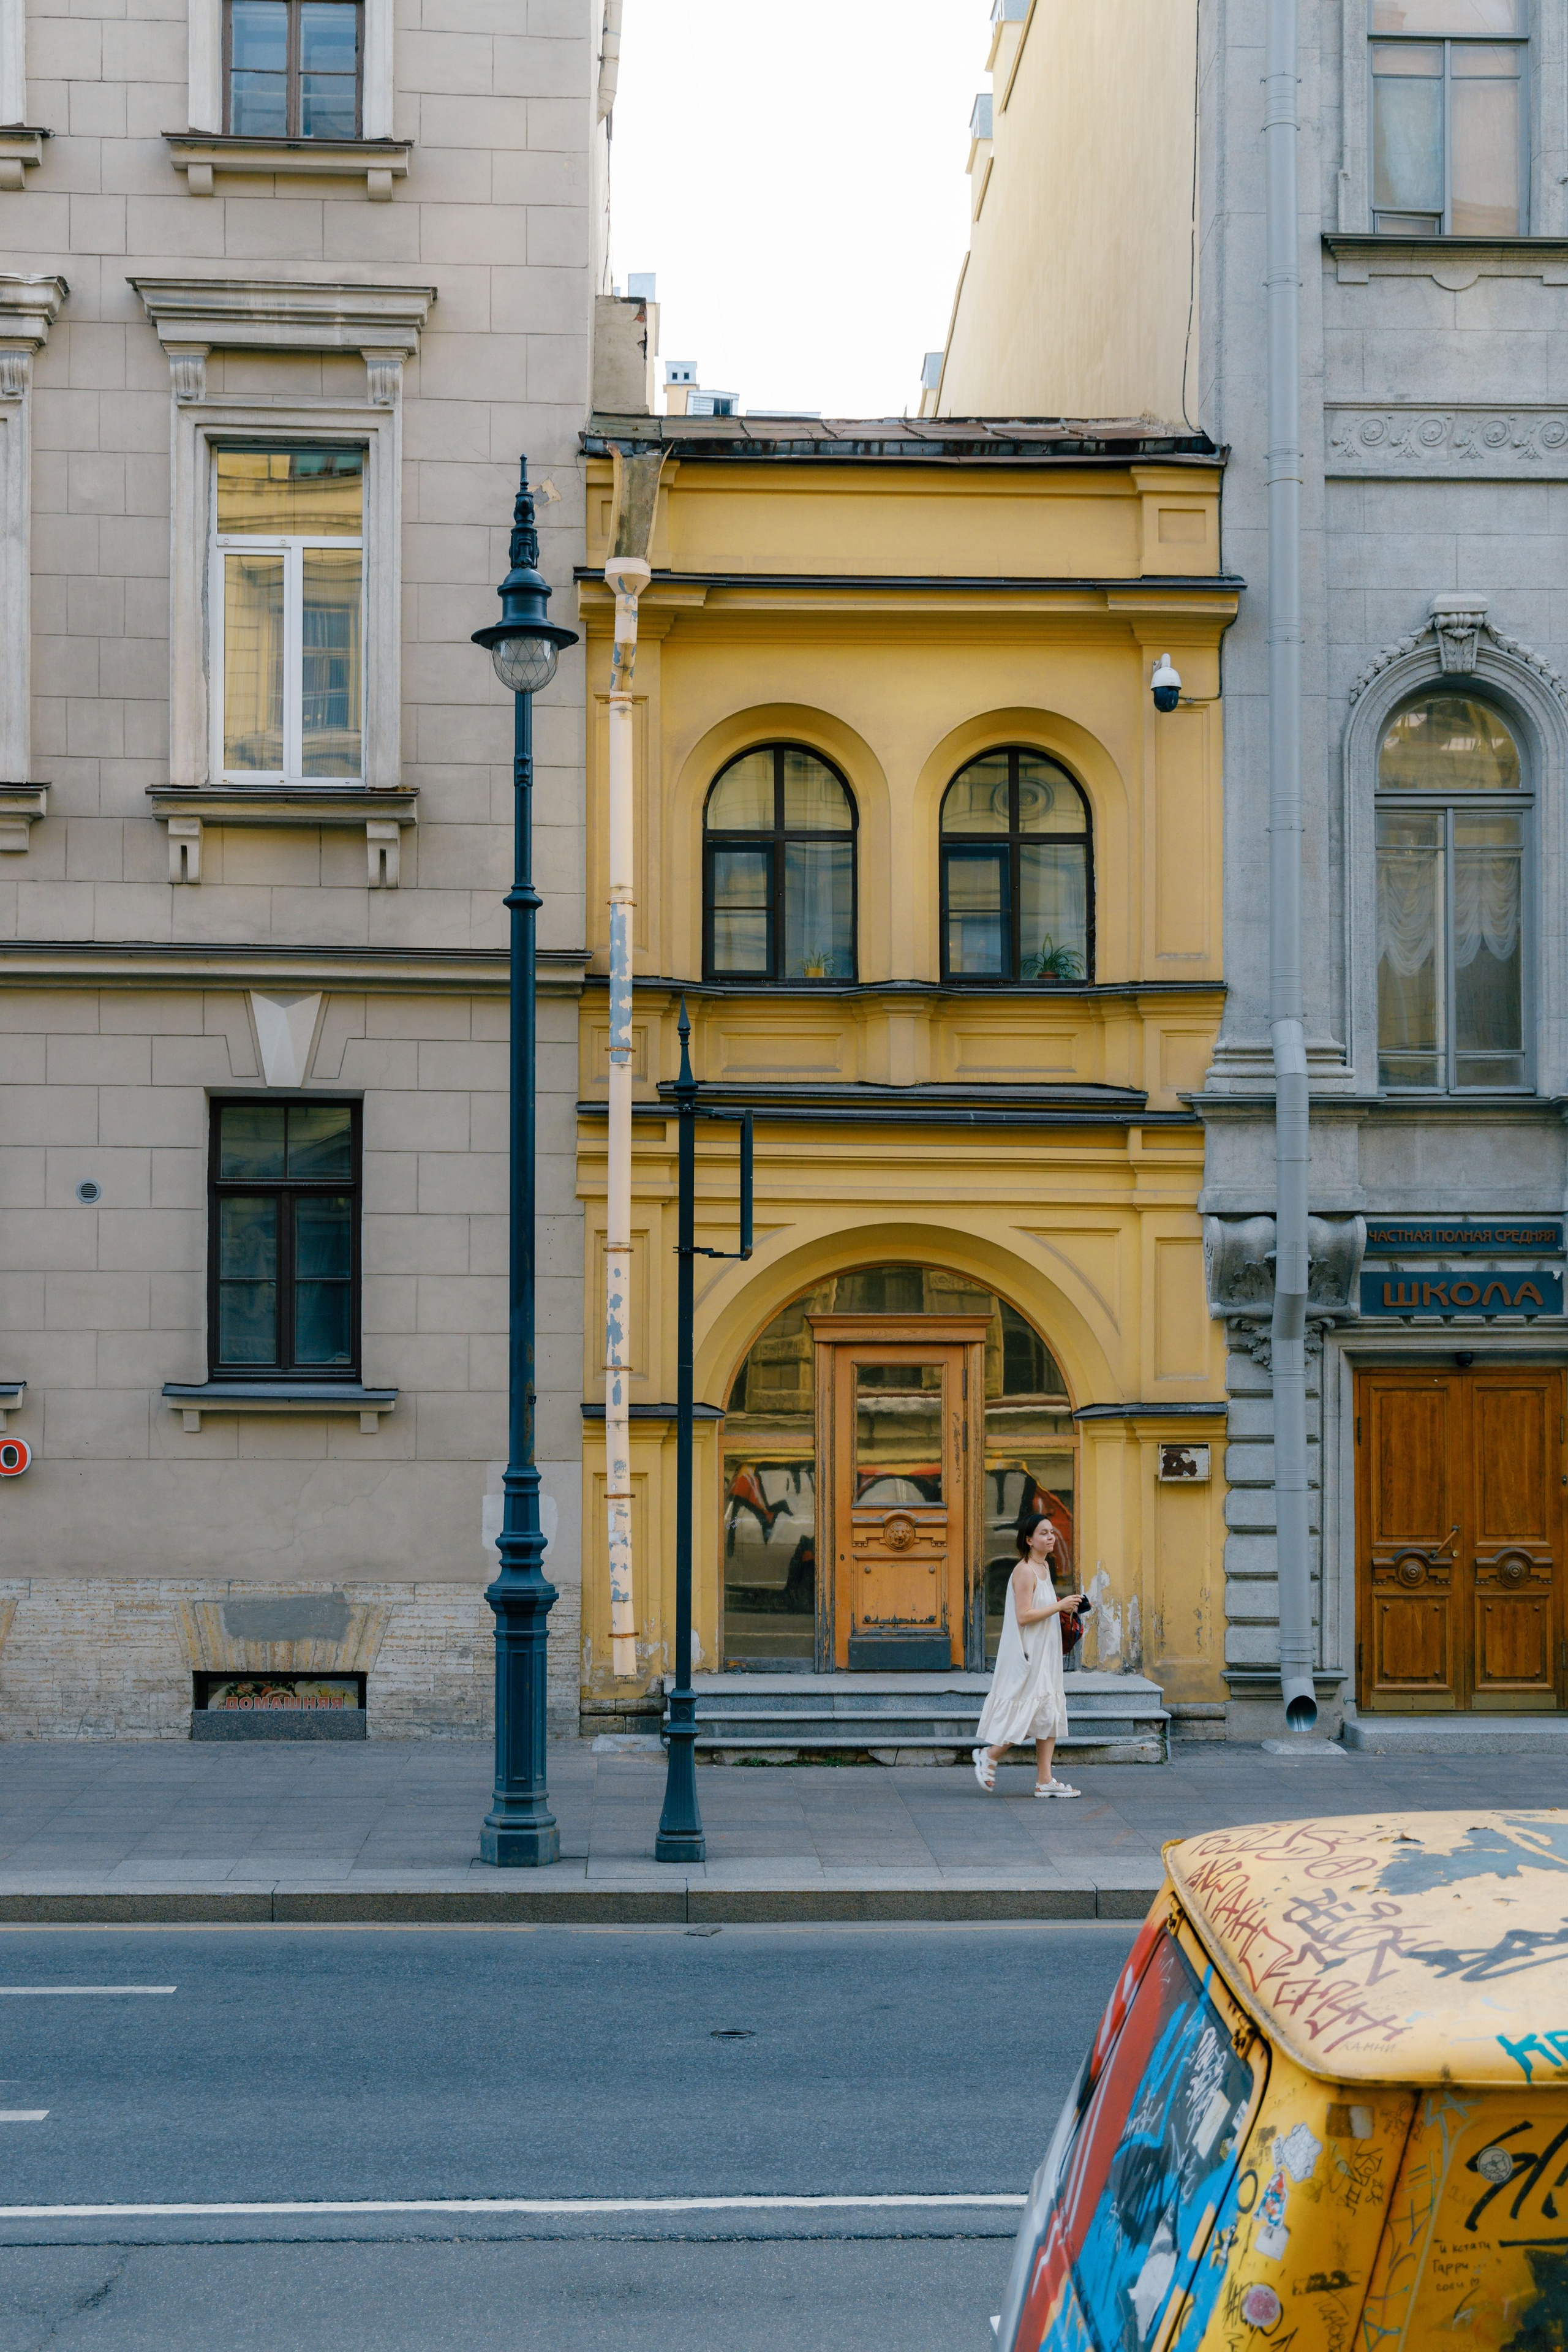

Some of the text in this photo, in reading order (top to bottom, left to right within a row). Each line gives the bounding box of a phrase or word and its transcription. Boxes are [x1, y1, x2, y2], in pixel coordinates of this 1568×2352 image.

[1368, 1229, 1556, 1245] ЧАСТНАЯ ПОЛНАЯ СРЕДНЯЯ
[1383, 1281, 1544, 1306] ШКОЛА
[225, 1696, 344, 1710] ДОМАШНЯЯ
